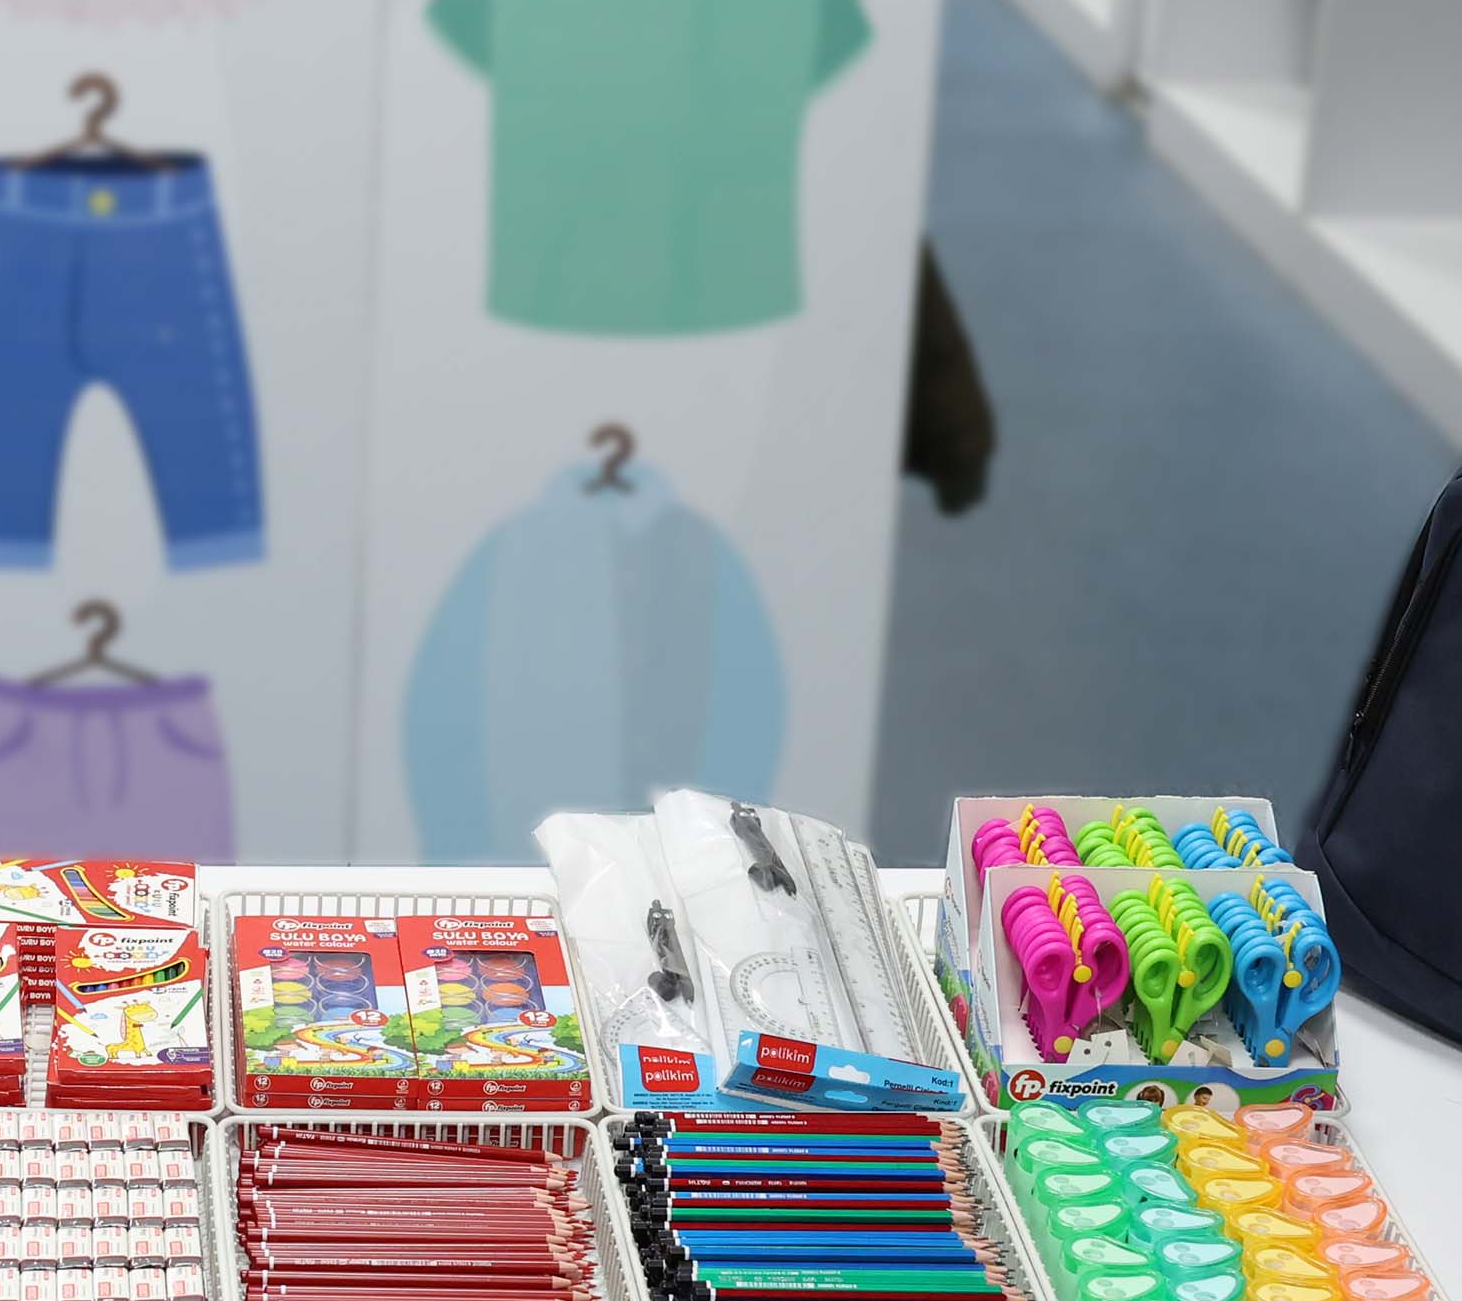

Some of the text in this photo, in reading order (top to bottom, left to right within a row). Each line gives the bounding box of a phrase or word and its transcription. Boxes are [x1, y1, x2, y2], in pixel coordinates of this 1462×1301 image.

[301, 921, 353, 930] fixpoint
[463, 920, 515, 929] fixpoint
[120, 936, 174, 945] fixpoint
[269, 932, 367, 943] SULU BOYA
[432, 931, 530, 942] SULU BOYA
[482, 939, 519, 947] colour
[355, 1010, 382, 1022] 12
[524, 1011, 551, 1023] 12
[760, 1046, 810, 1064] polikim
[257, 1077, 268, 1085] 12
[645, 1069, 694, 1084] polikim
[430, 1082, 441, 1090] 12
[1014, 1074, 1117, 1100] fp fixpoint
